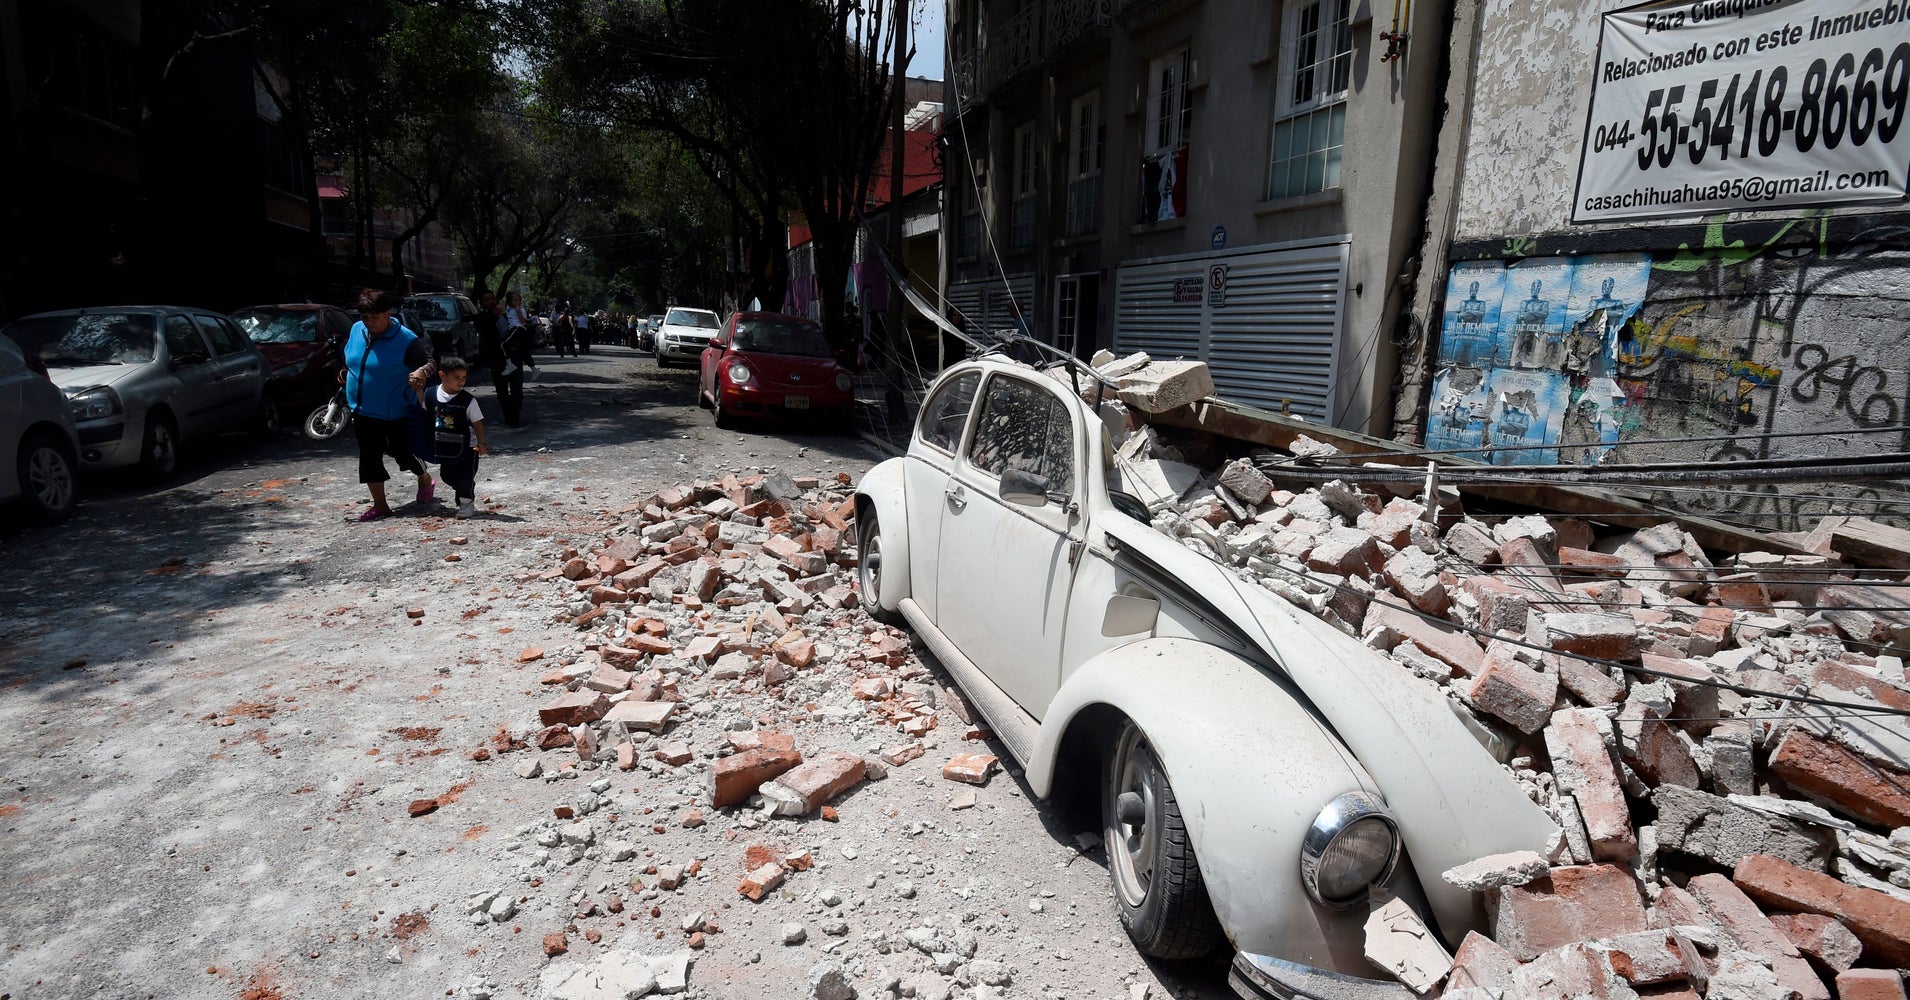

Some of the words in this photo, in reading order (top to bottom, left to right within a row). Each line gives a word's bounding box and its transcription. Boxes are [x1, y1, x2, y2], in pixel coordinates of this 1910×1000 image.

[1603, 43, 1707, 84] Relacionado
[1713, 37, 1750, 62] con
[1756, 23, 1803, 52] este
[1809, 0, 1910, 42] Inmuebl
[1645, 10, 1685, 34] Para
[1594, 119, 1635, 153] 044-
[1637, 42, 1910, 171] 55-5418-8669
[1584, 169, 1890, 212] casachihuahua95@gmail.com
